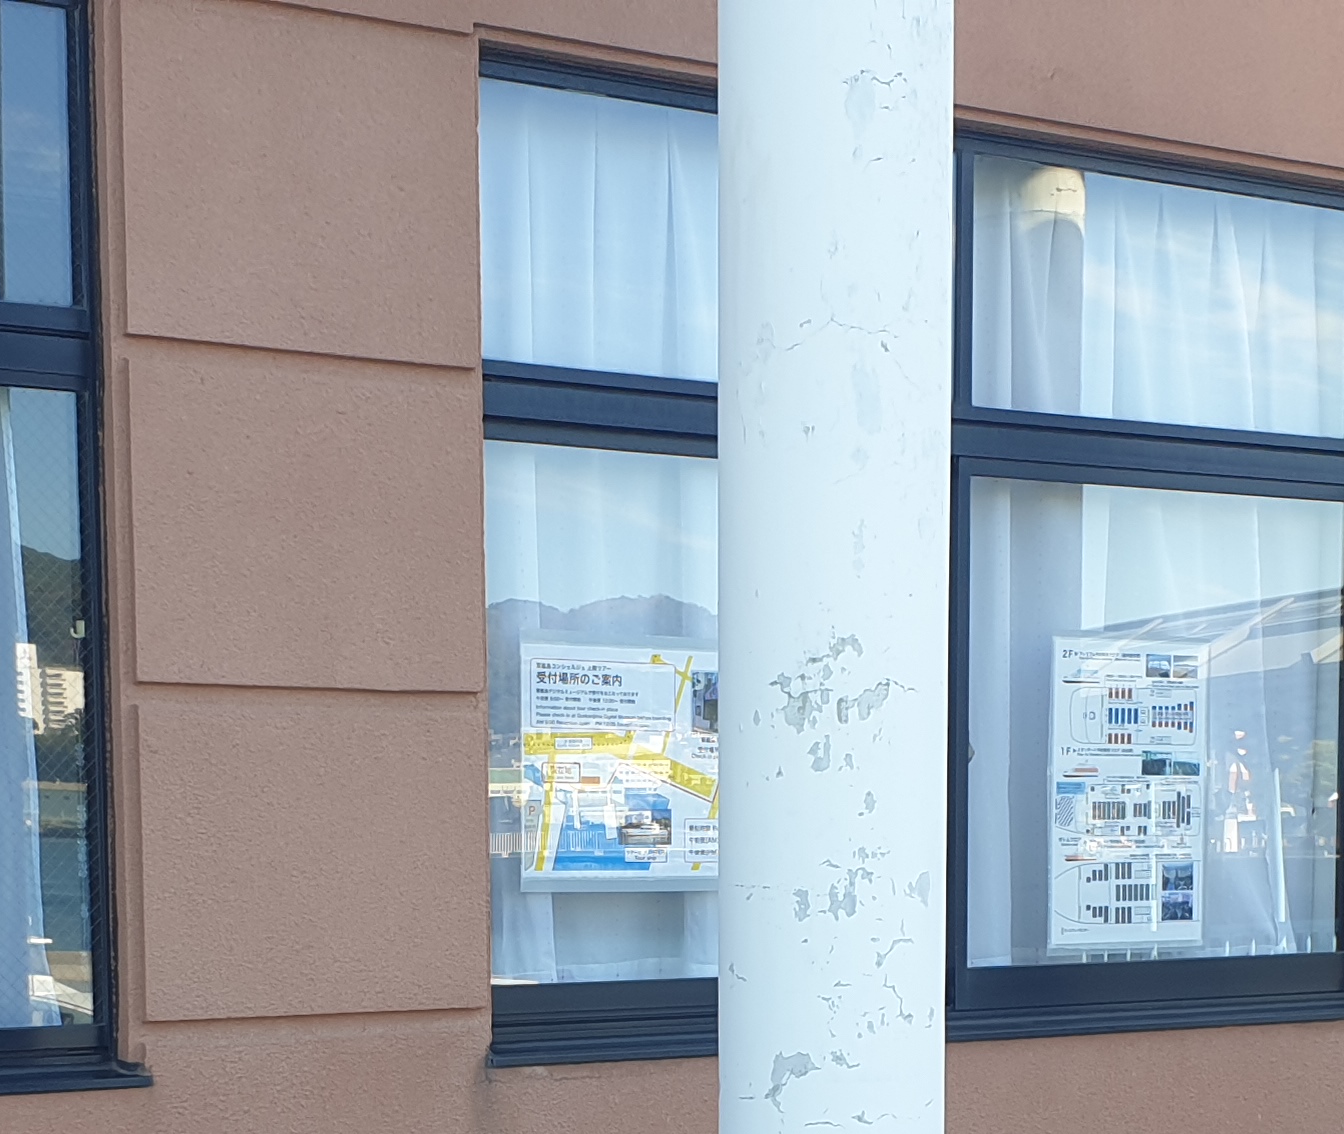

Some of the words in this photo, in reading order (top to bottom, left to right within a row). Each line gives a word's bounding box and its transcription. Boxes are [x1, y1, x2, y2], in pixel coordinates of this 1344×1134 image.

[536, 671, 622, 687] 受付場所のご案内
[528, 805, 536, 816] P
